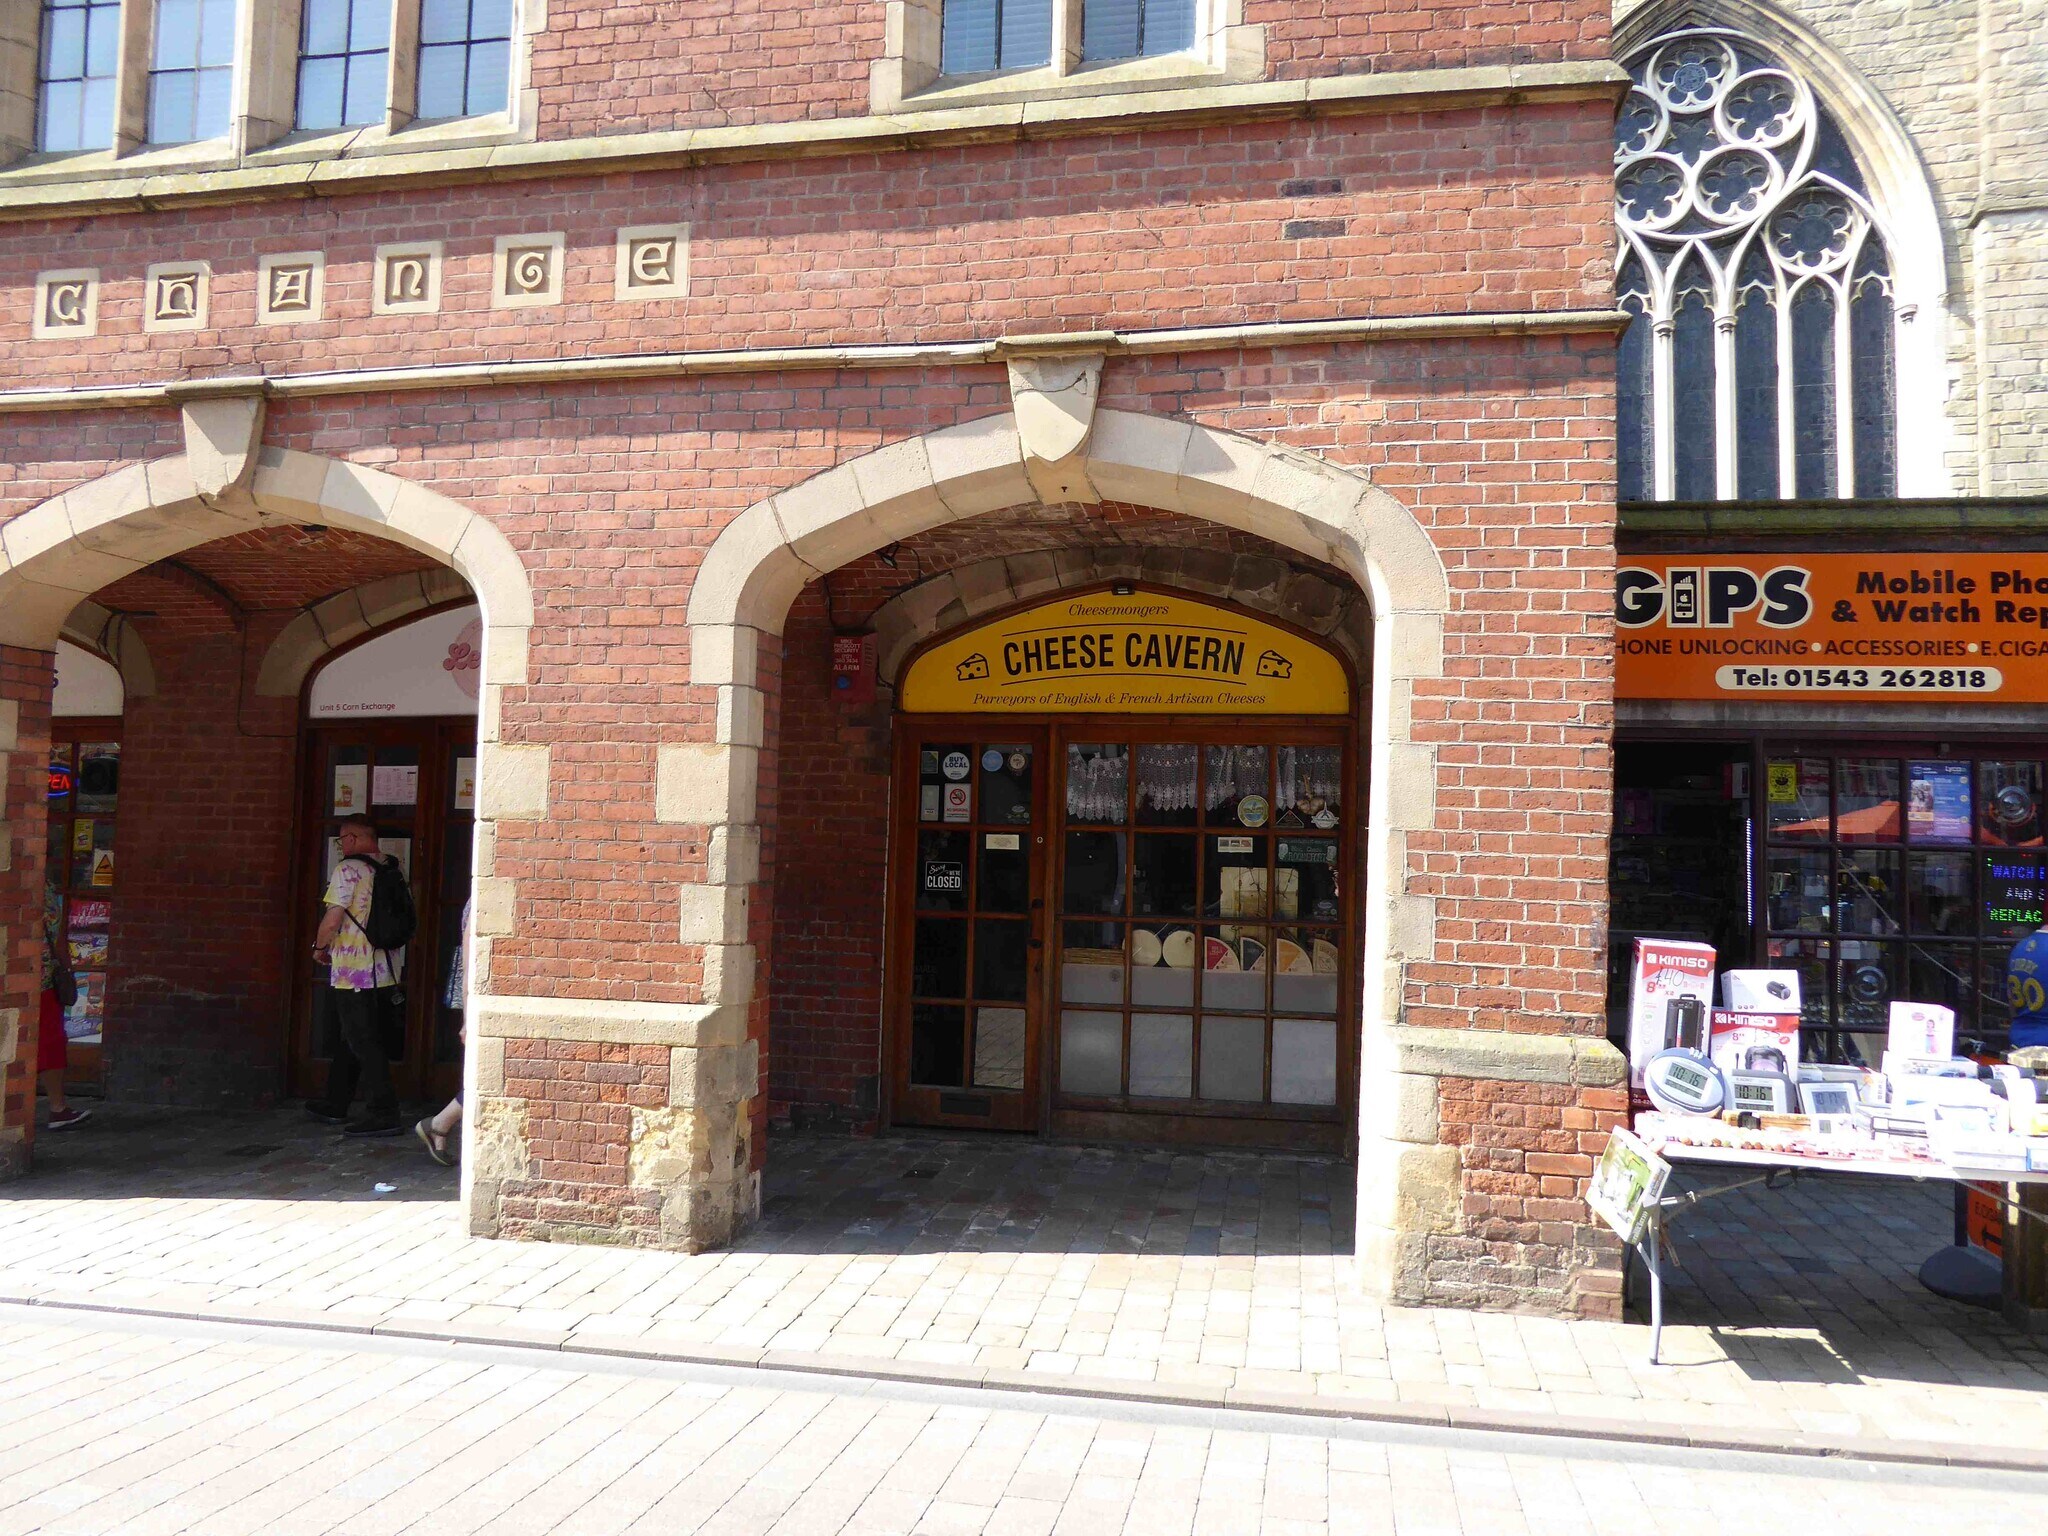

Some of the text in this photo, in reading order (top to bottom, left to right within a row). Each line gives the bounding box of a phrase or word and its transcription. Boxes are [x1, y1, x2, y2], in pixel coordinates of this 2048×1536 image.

[1856, 569, 1976, 594] Mobile
[1616, 565, 1813, 629] GIPS
[1068, 603, 1169, 618] Cheesemongers
[1831, 600, 1858, 622] &
[1872, 598, 1980, 622] Watch
[1003, 632, 1245, 676] CHEESE CAVERN
[1680, 639, 1808, 655] UNLOCKING
[1824, 640, 1966, 656] ACCESSORIES
[1733, 668, 1986, 688] Tel: 01543 262818
[361, 702, 396, 712] Exchange
[973, 692, 1266, 706] Purveyors of English & French Artisan Cheeses
[929, 863, 946, 875] Sorry
[1992, 865, 2035, 879] WATCH
[927, 875, 961, 888] CLOSED
[1659, 955, 1708, 969] KIMISO
[2007, 975, 2045, 1013] 30
[1727, 1013, 1777, 1027] KIMISO
[1672, 1065, 1701, 1087] 10:16
[1739, 1084, 1767, 1101] 10:16
